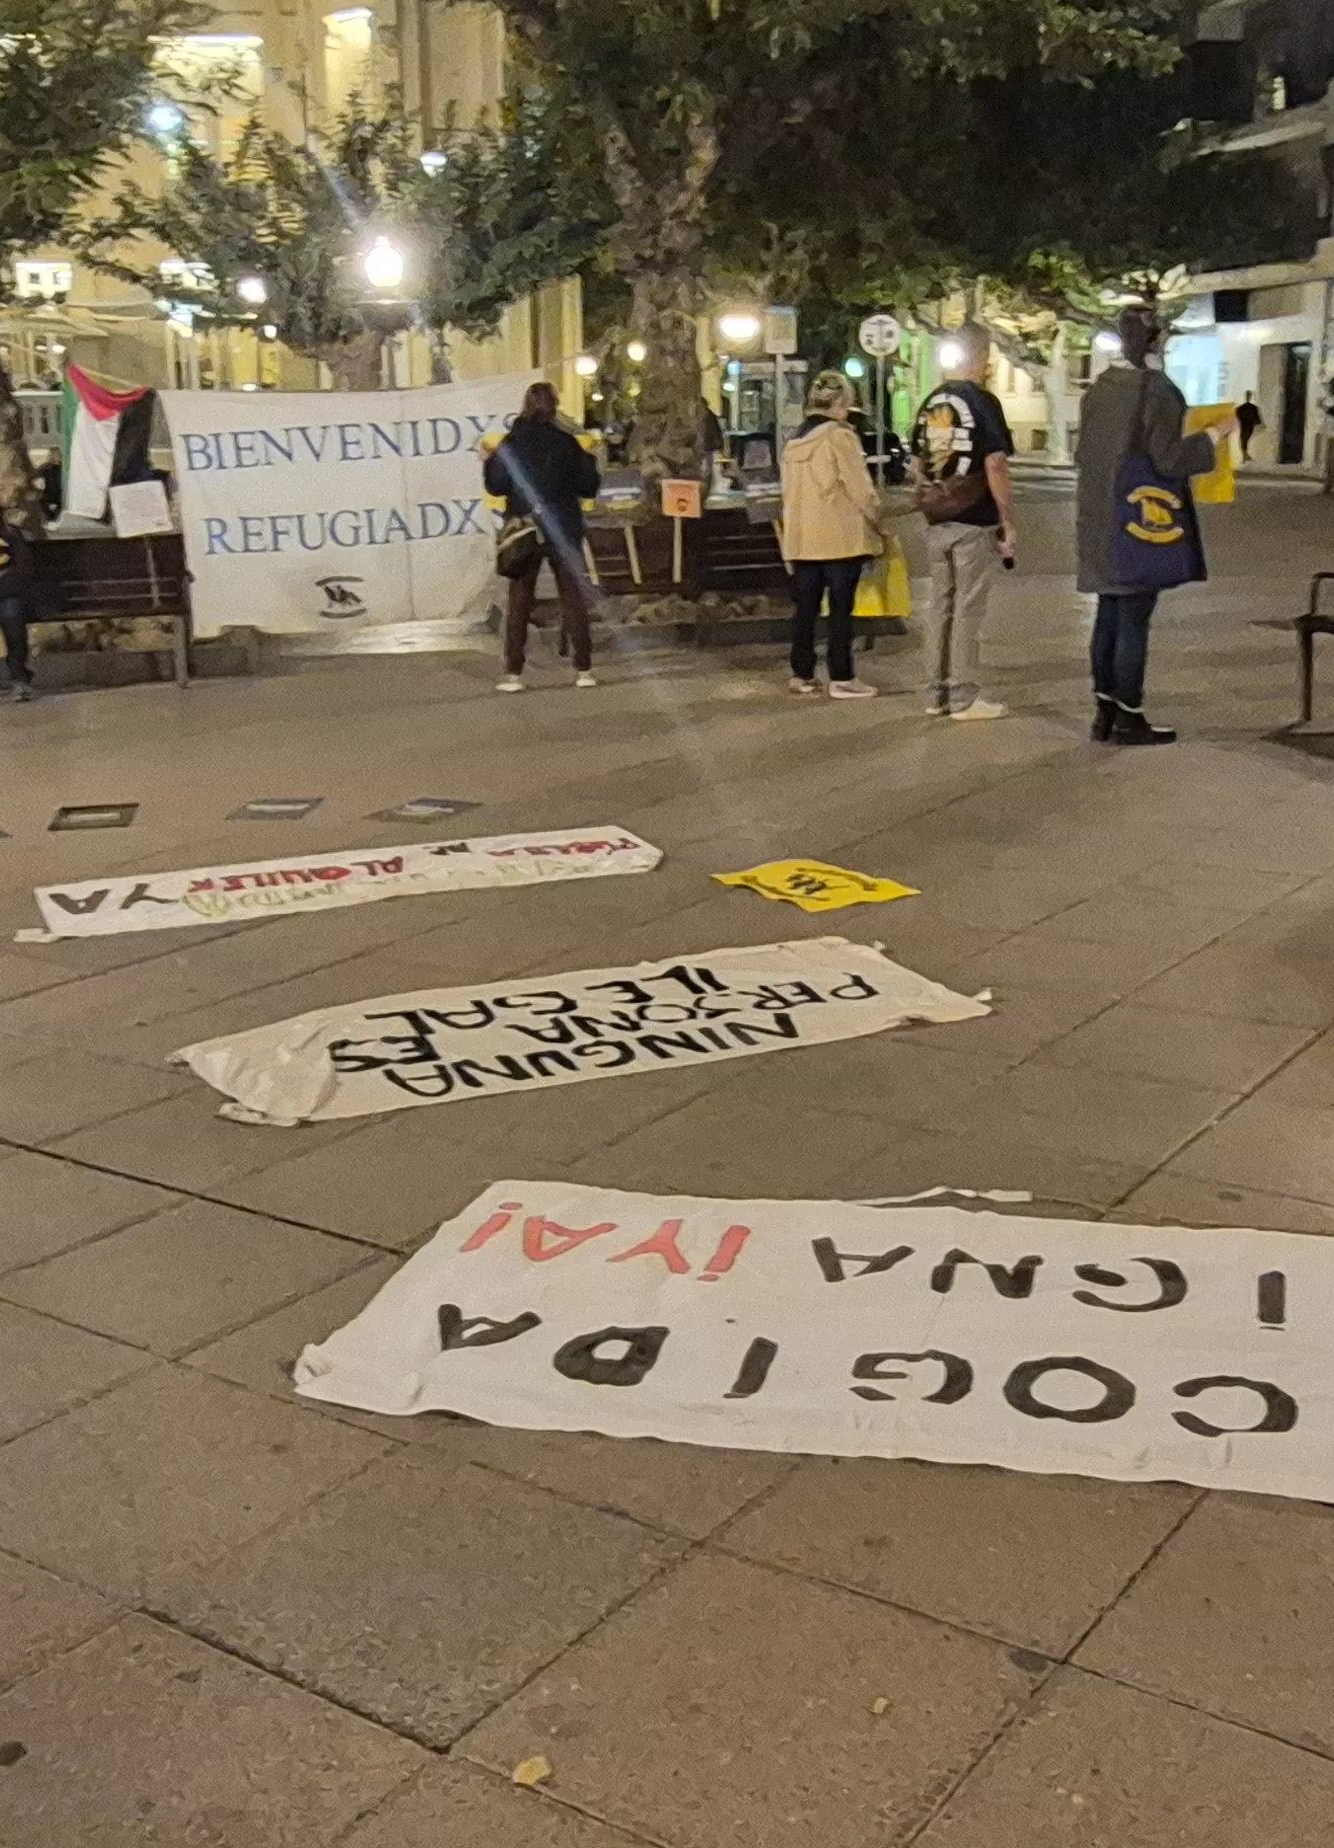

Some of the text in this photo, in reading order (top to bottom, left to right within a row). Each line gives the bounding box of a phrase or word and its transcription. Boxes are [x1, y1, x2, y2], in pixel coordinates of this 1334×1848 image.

[203, 498, 506, 555] REFUGIADX
[327, 1034, 438, 1074] ES
[384, 1011, 800, 1097] NINGUNA
